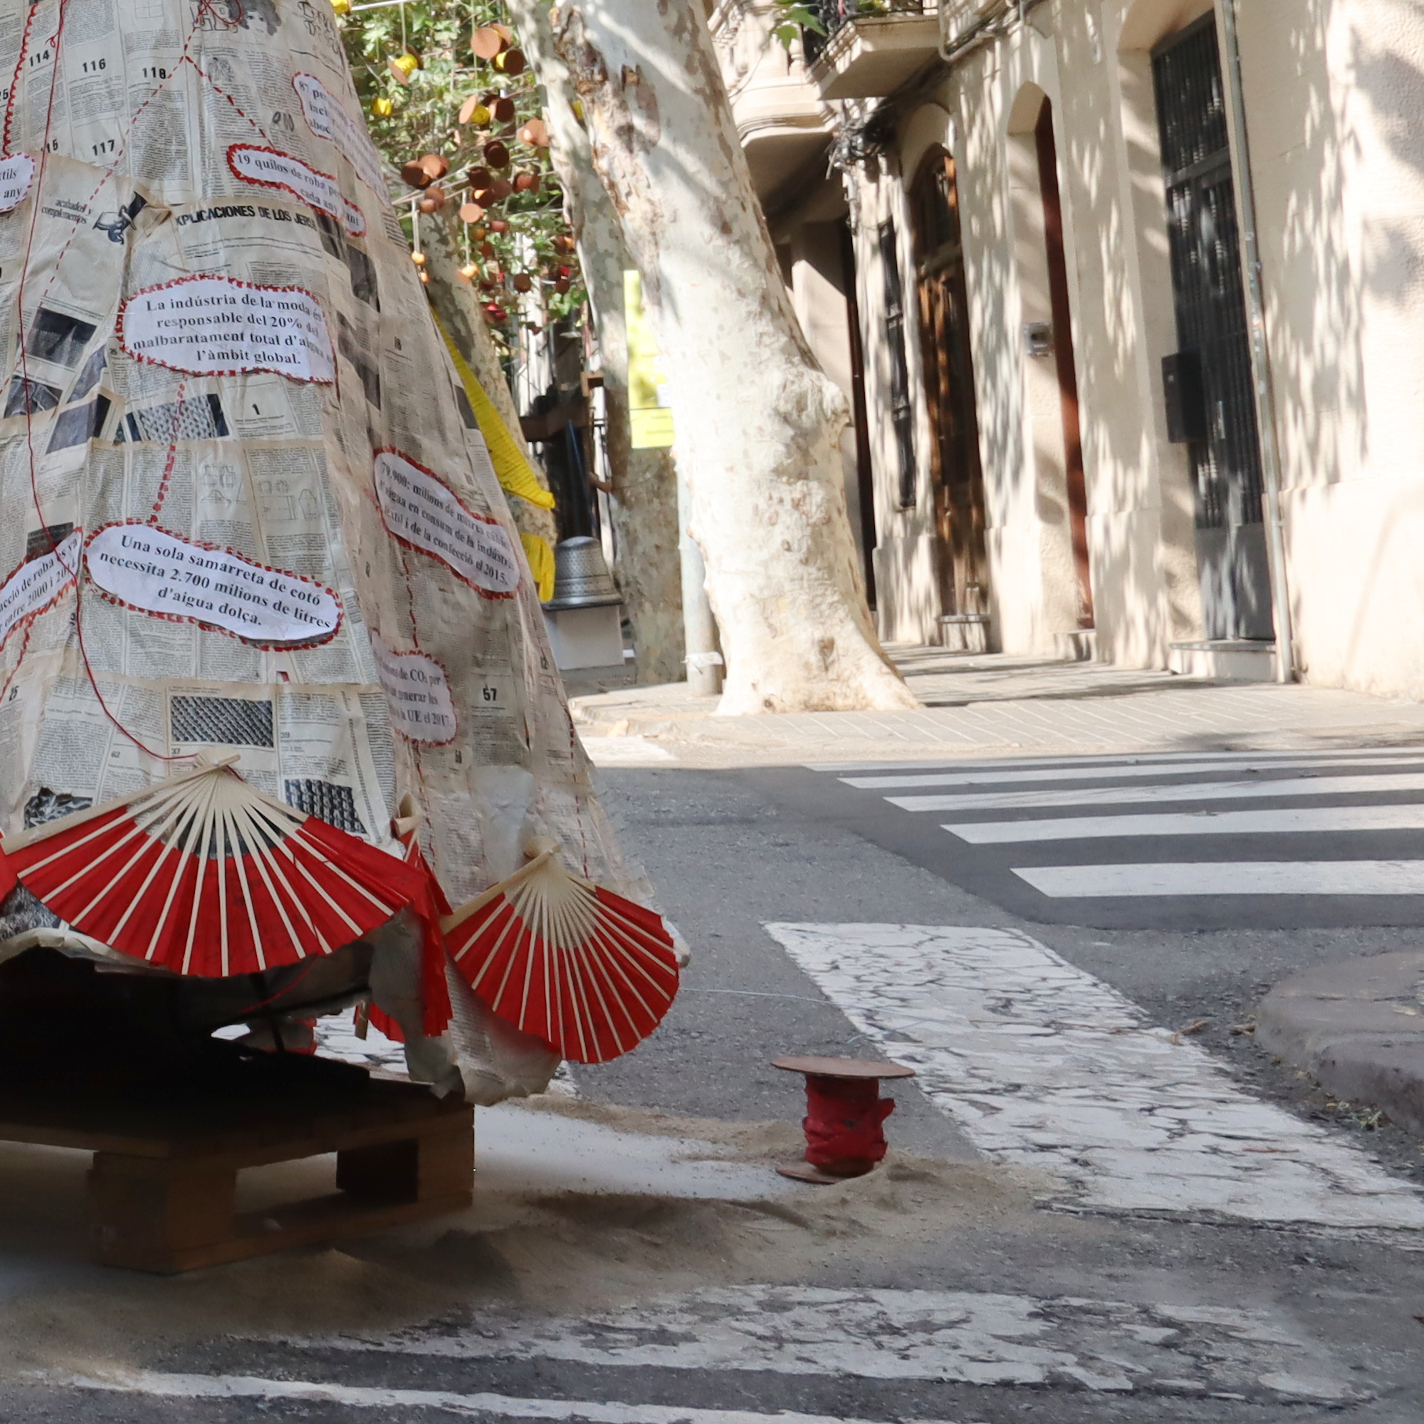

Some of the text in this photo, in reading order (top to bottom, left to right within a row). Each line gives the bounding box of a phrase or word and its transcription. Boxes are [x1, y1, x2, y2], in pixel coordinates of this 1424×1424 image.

[30, 50, 49, 66] 114
[83, 59, 106, 72] 116
[143, 67, 166, 79] 118
[92, 140, 115, 156] 117
[238, 154, 326, 190] 19 quilos de roba
[3, 188, 22, 201] any
[300, 189, 321, 205] cada
[258, 207, 273, 219] DE
[273, 209, 292, 221] LOS
[146, 300, 165, 311] La
[170, 295, 237, 309] indústria
[241, 294, 257, 306] de
[260, 296, 273, 309] la
[277, 301, 310, 315] moda
[157, 312, 243, 329] responsable
[247, 313, 267, 326] del
[270, 316, 302, 329] 20%
[133, 332, 245, 350] malbaratament
[250, 334, 280, 345] total
[254, 352, 301, 364] global.
[408, 503, 419, 515] en
[411, 522, 421, 535] de
[21, 579, 32, 592] de
[33, 558, 54, 581] roba
[121, 535, 320, 606] Una sola samarreta de cotó
[99, 552, 331, 628] necessita 2.700 milions de litres
[4, 603, 26, 628] entre
[27, 584, 48, 606] 2000
[157, 587, 261, 625] d'aigua dolça.
[483, 688, 497, 702] 57
